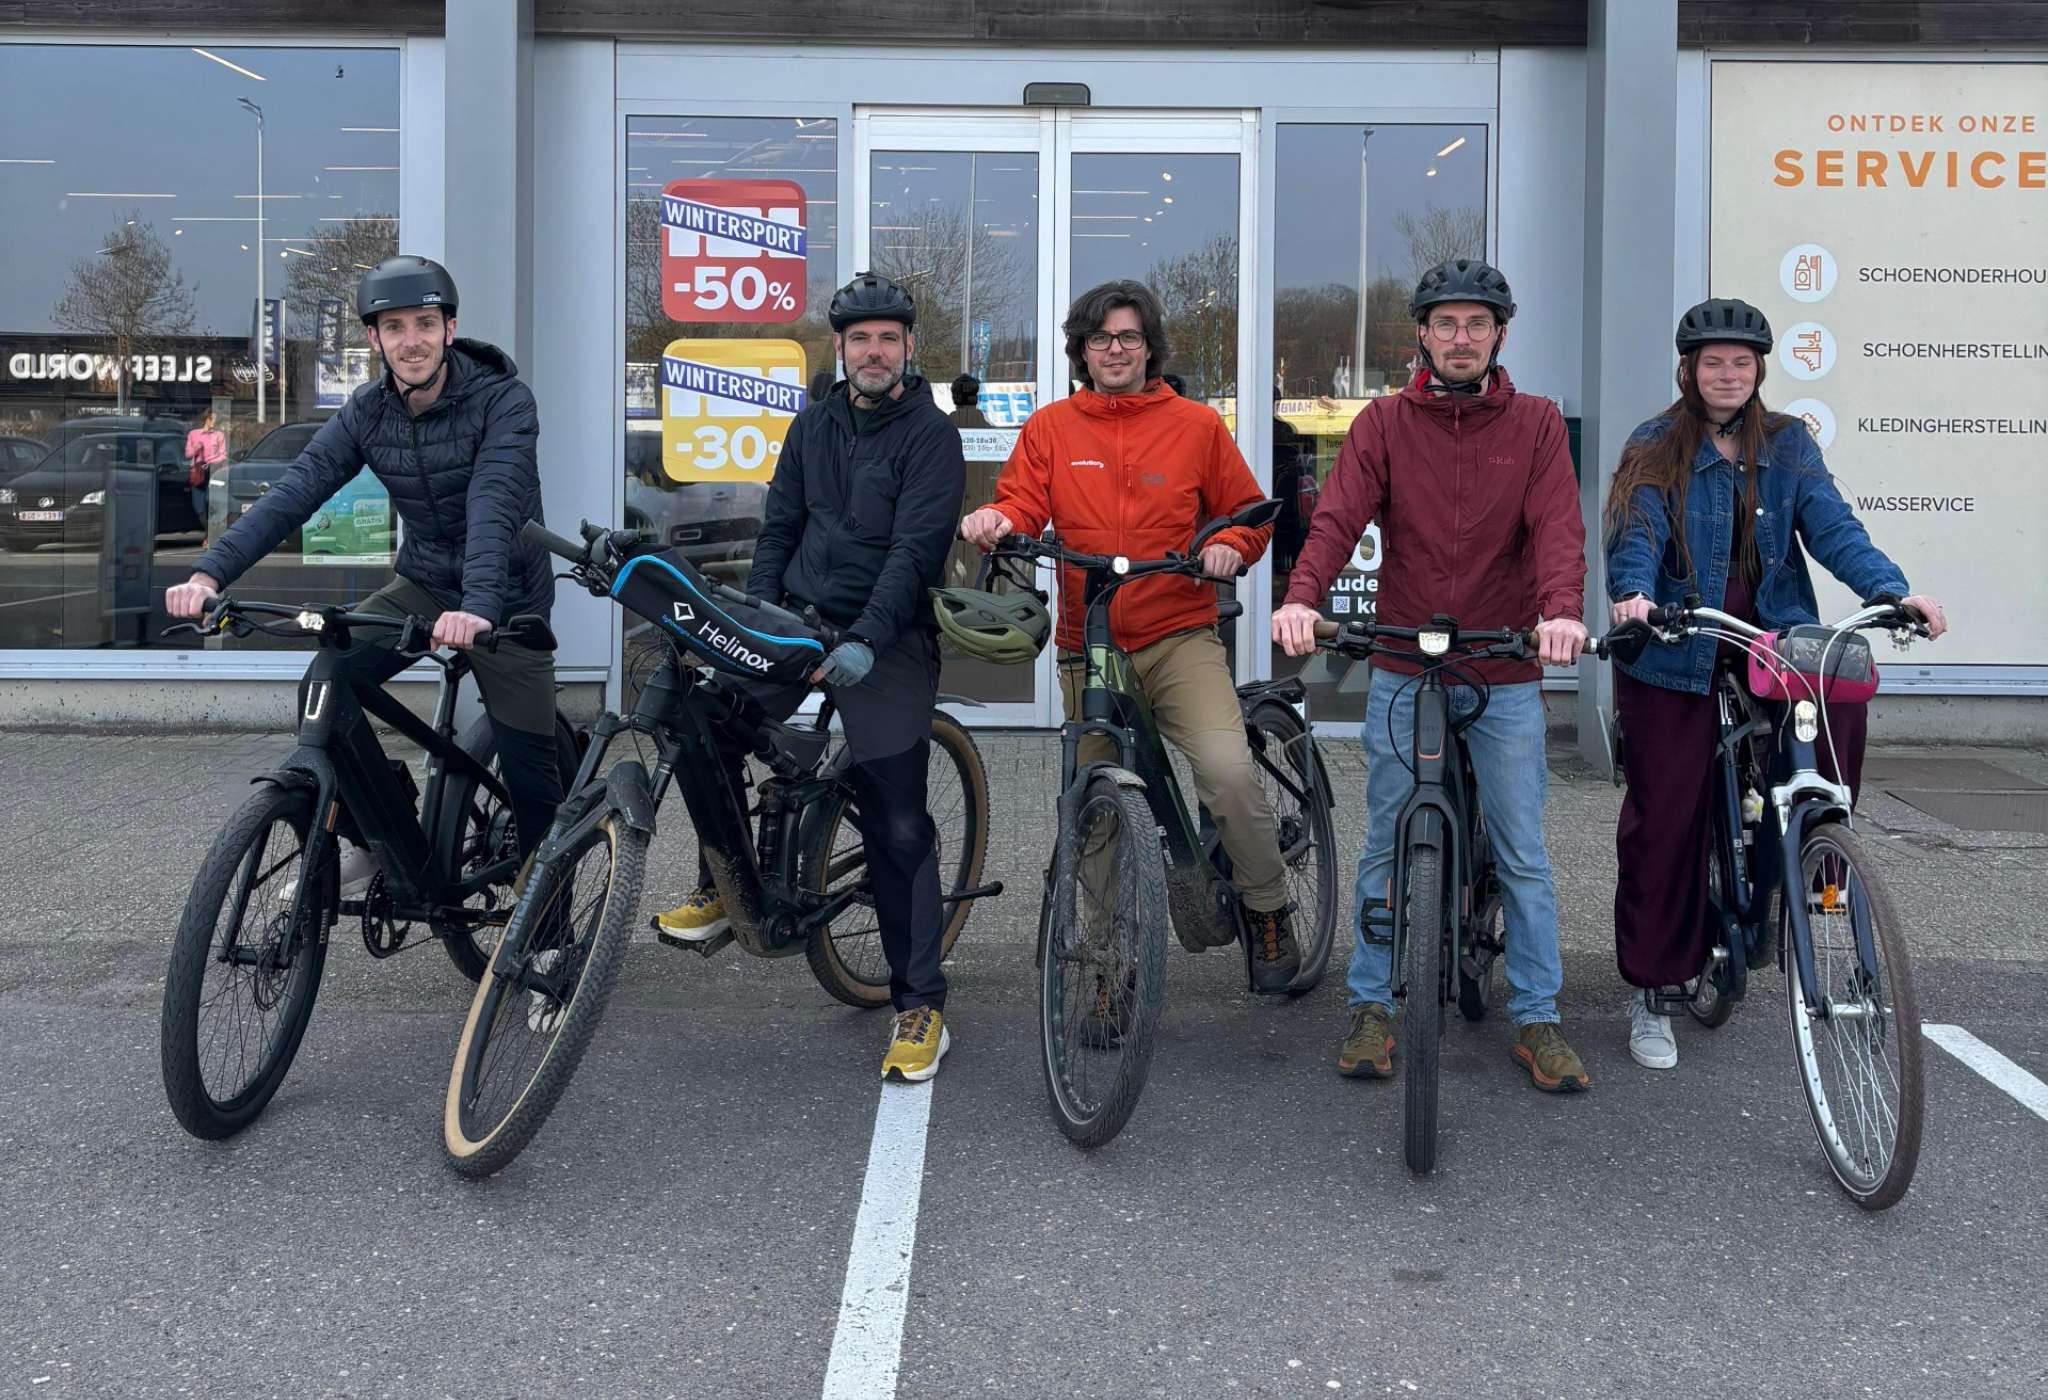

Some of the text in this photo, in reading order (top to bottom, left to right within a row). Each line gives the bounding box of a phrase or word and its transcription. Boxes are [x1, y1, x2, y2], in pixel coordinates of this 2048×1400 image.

[1827, 114, 2036, 133] ONTDEK ONZE
[1773, 149, 2046, 188] SERVICE
[665, 200, 802, 252] WINTERSPORT
[674, 266, 796, 311] -50%
[1858, 267, 2047, 284] SCHOENONDERHOU
[1863, 342, 2048, 359] SCHOENHERSTELLIN
[665, 361, 803, 411] WINTERSPORT
[1857, 417, 2048, 434] KLEDINGHERSTELLIN
[1857, 496, 1975, 512] WASSERVICE
[697, 620, 776, 673] Helinox
